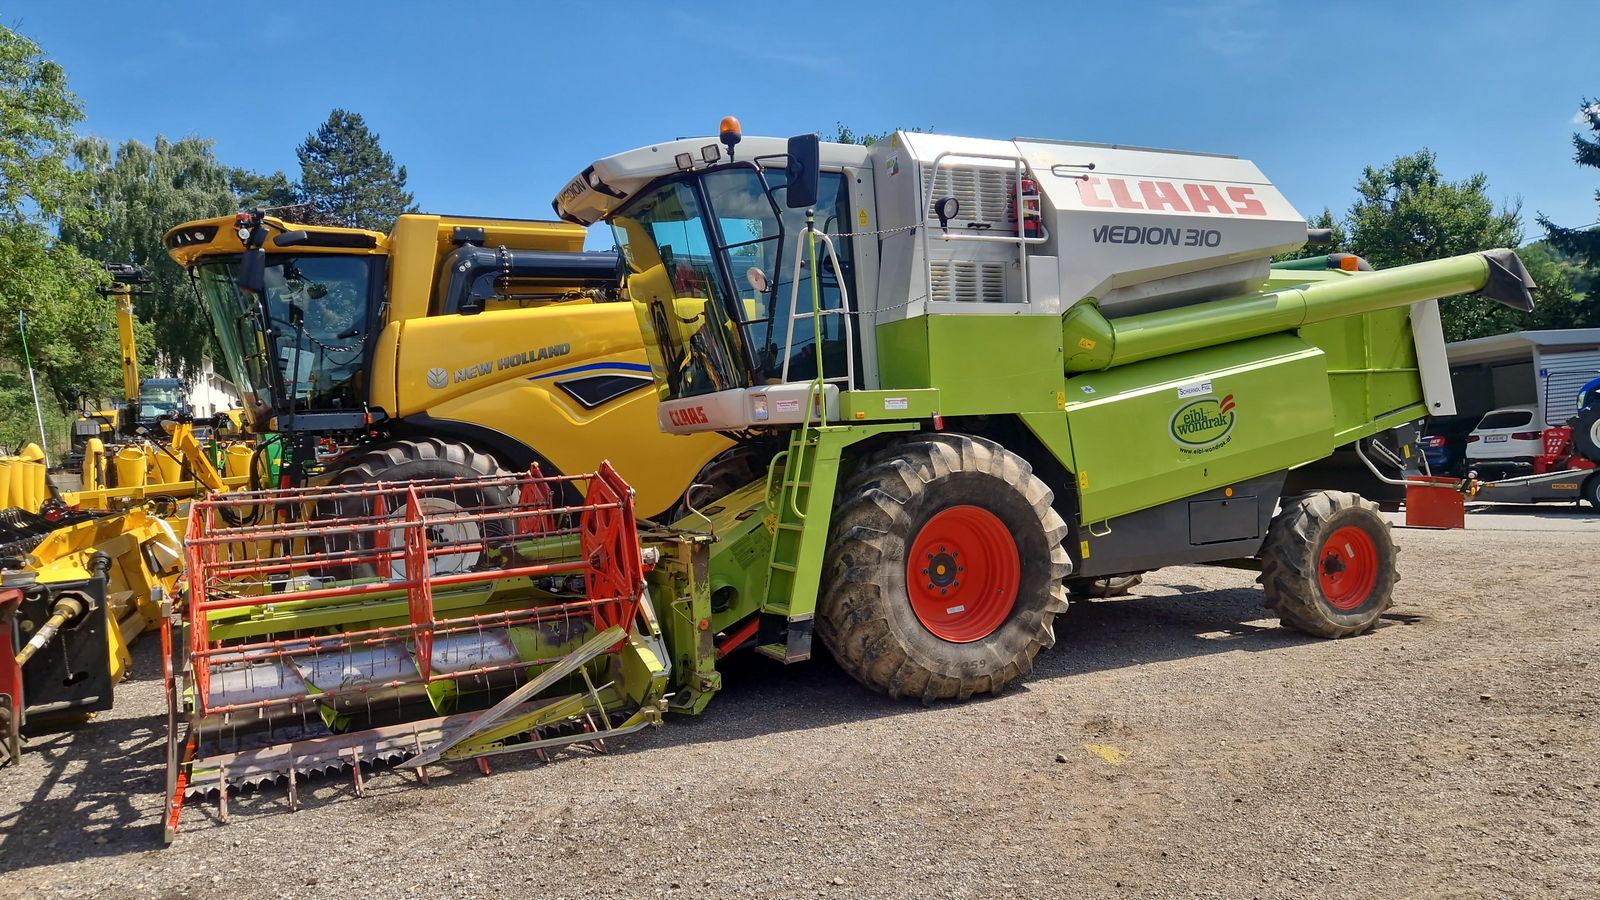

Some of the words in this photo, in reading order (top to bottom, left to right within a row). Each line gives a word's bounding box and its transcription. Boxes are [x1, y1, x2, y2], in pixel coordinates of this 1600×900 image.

[1075, 177, 1267, 216] CLAAS
[1092, 225, 1181, 246] MEDION
[1184, 228, 1222, 248] 310
[454, 361, 493, 383] NEW
[497, 342, 571, 371] HOLLAND
[669, 405, 709, 427] CLAAS
[1177, 413, 1227, 435] wondrak
[1179, 436, 1232, 454] www.eibl-wondrak.at
